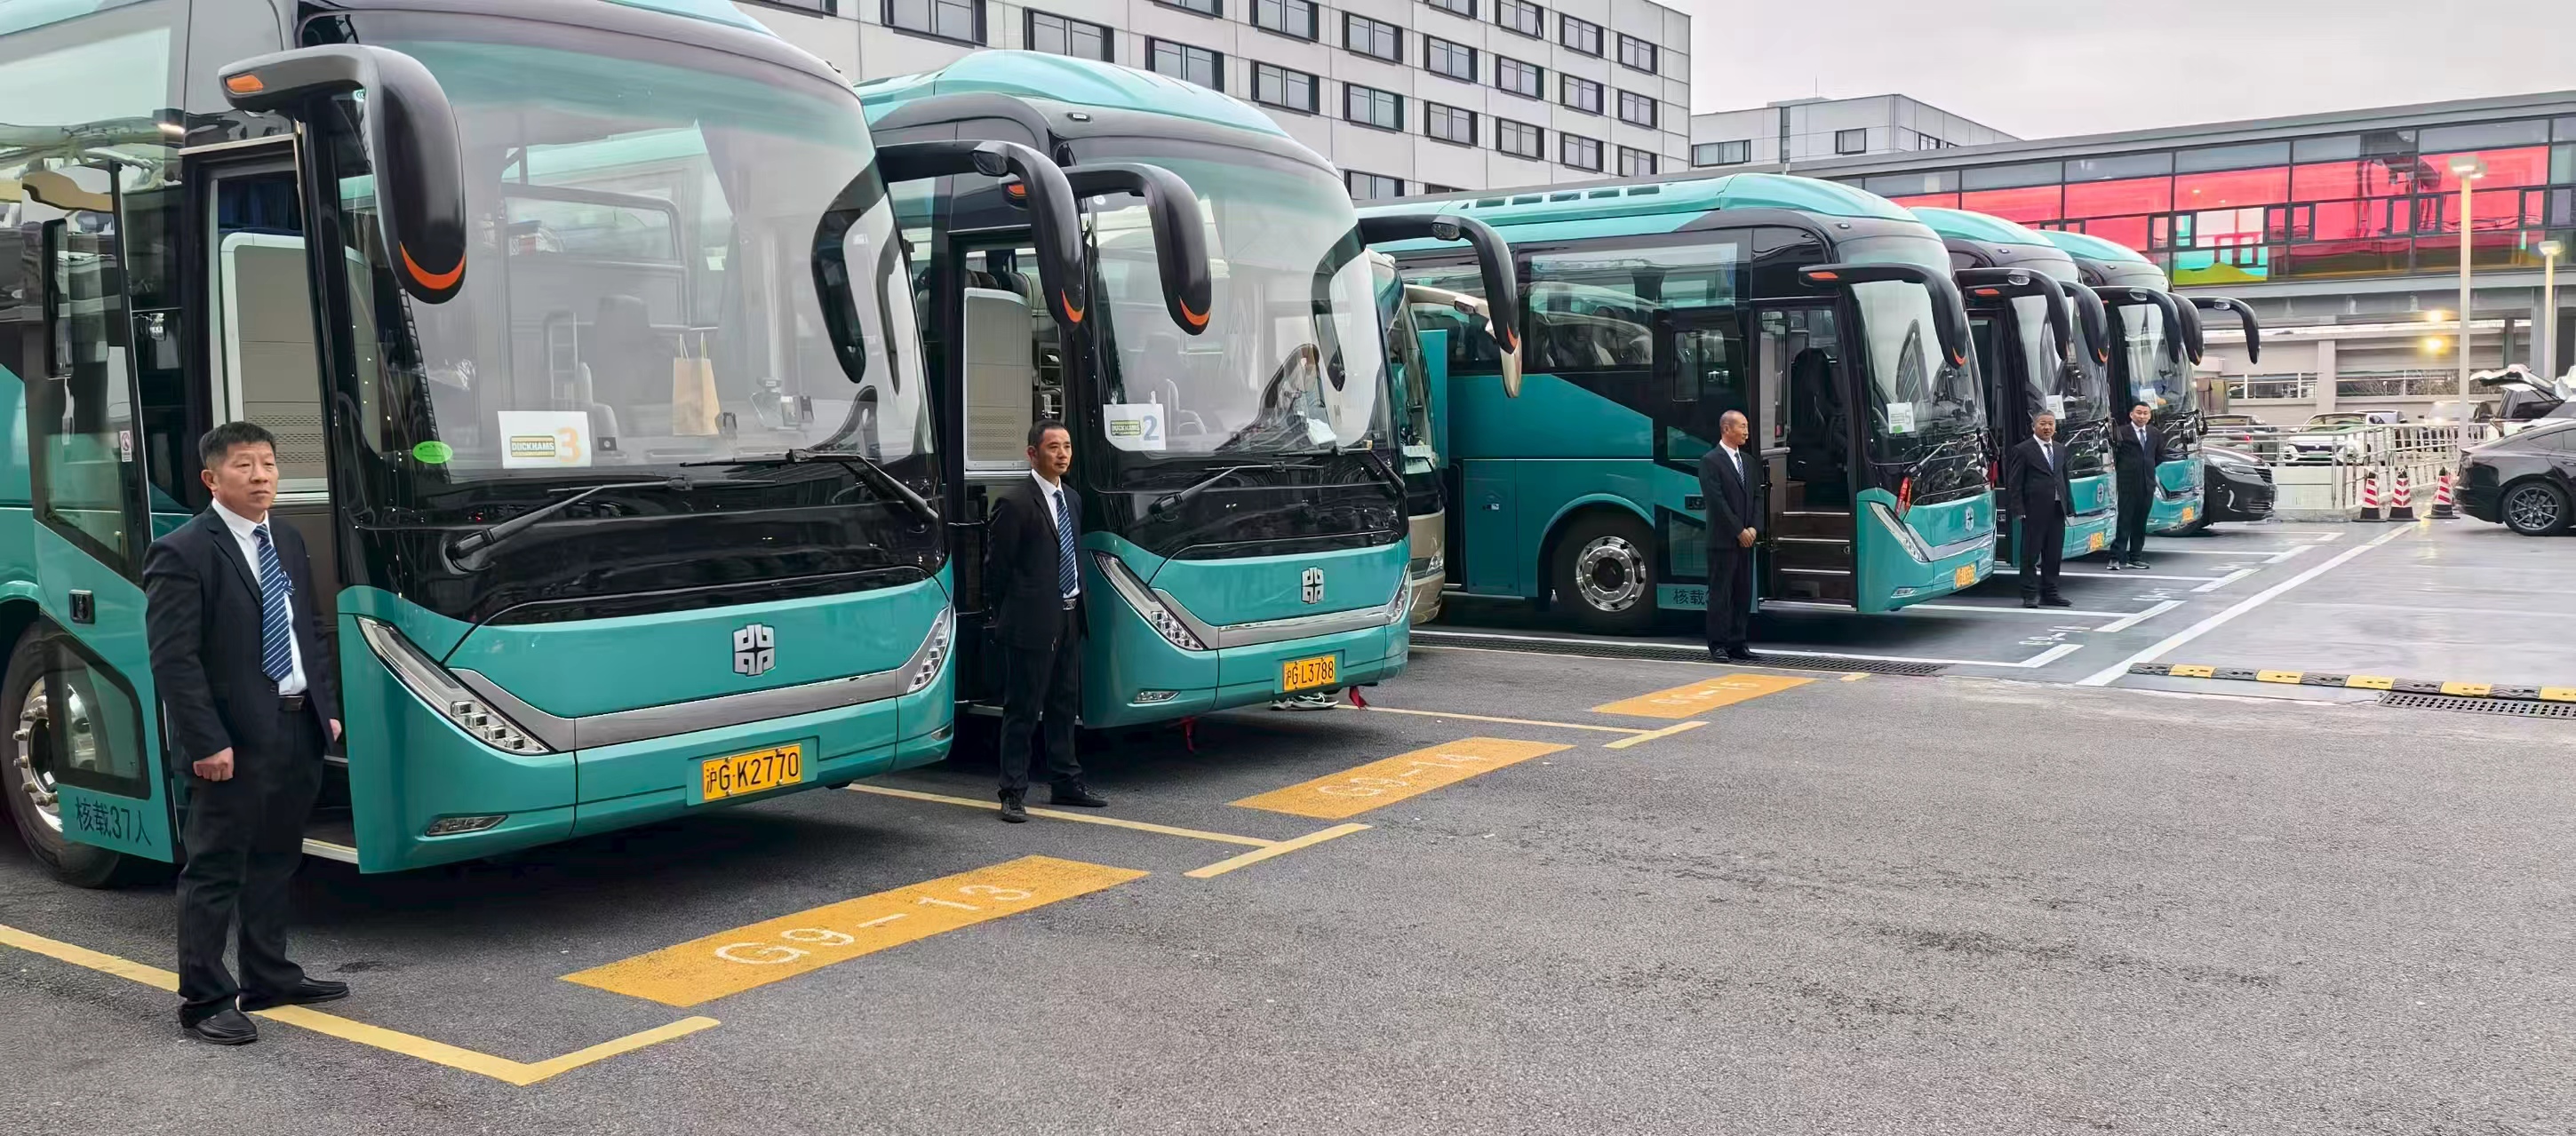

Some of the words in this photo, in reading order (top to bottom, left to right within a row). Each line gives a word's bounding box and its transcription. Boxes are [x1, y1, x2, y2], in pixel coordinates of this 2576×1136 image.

[511, 442, 554, 451] DUCKHAMS
[556, 426, 582, 464] 3
[1143, 415, 1159, 441] 2
[1673, 588, 1710, 605] 核载
[75, 796, 152, 846] 核载37人
[714, 885, 1033, 965] G9-13
